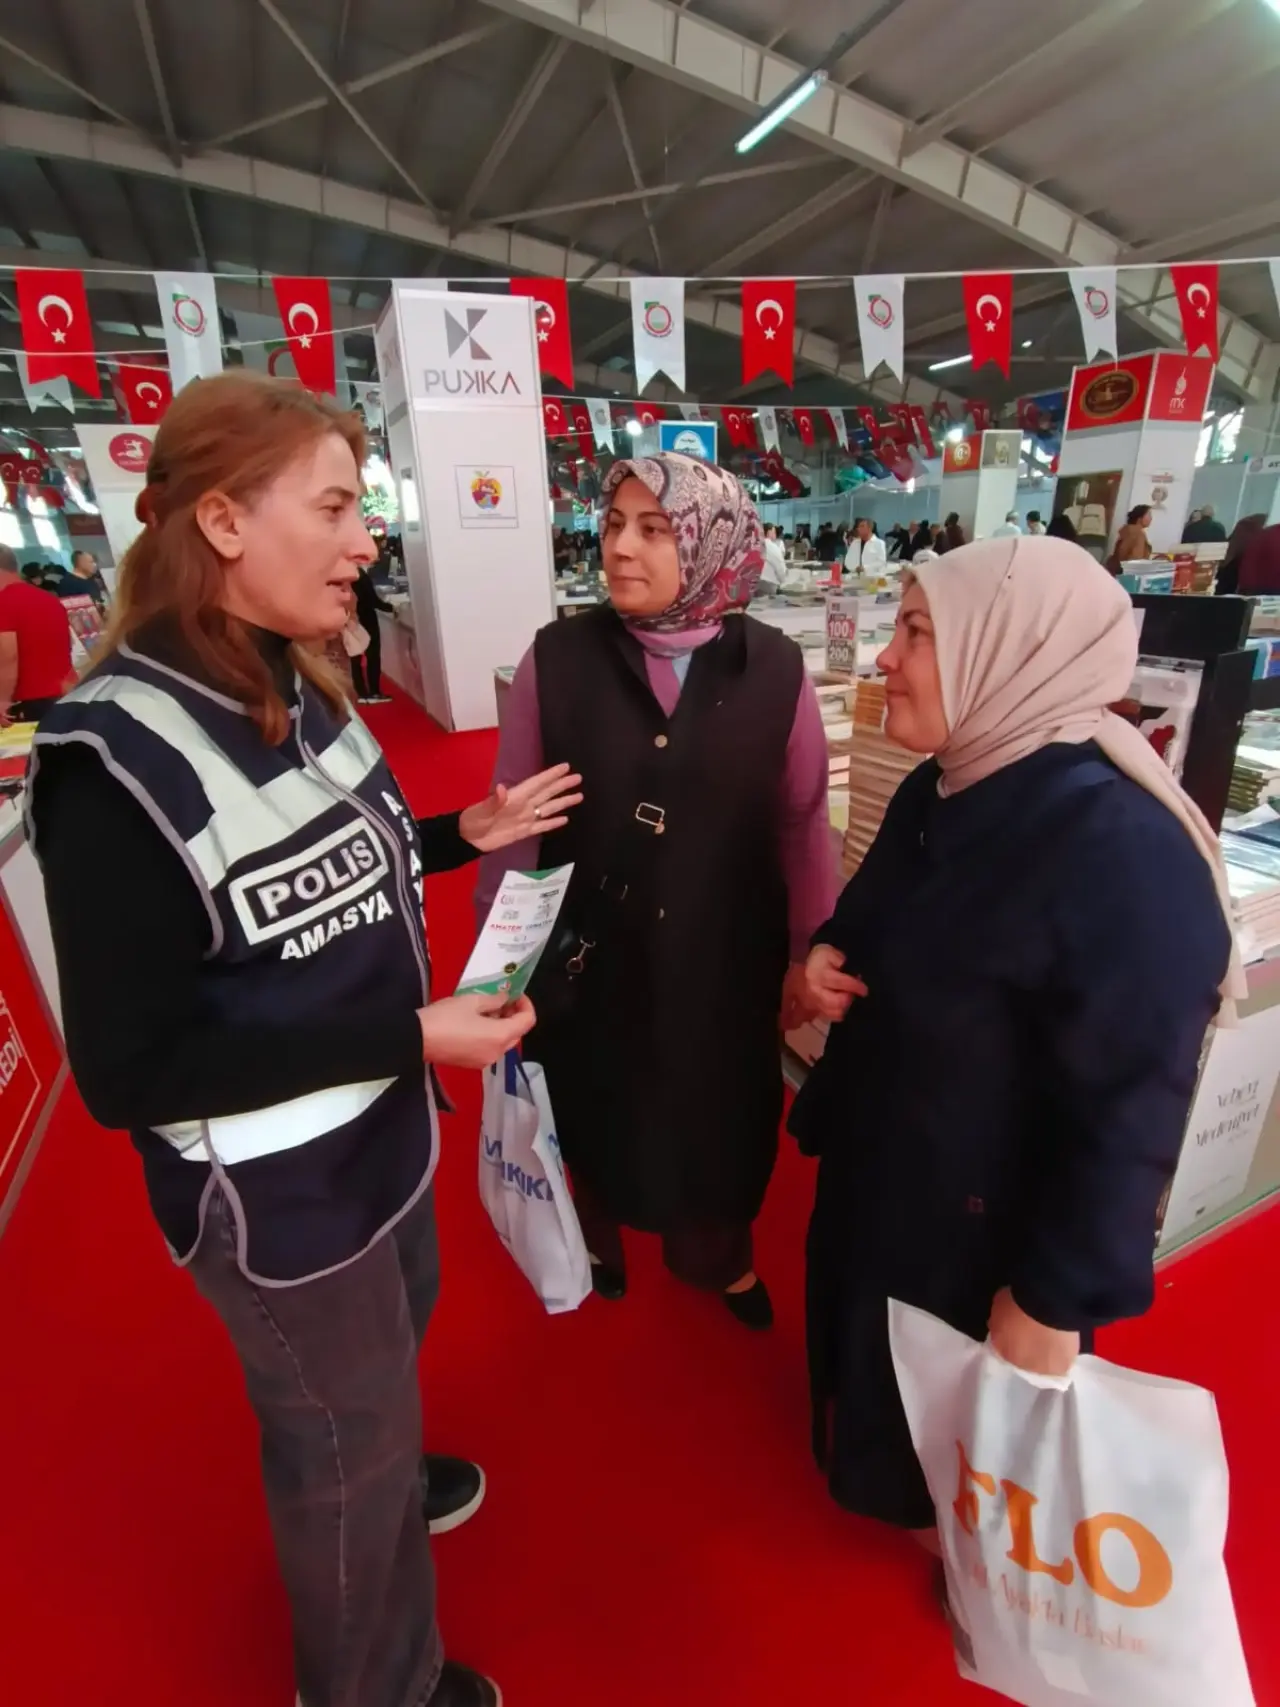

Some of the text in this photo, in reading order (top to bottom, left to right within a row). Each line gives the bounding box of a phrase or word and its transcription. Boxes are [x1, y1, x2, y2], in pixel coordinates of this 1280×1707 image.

[423, 369, 522, 395] PUKKA
[829, 620, 850, 638] 100
[280, 890, 394, 961] AMASYA
[952, 1438, 1173, 1609] FLO
